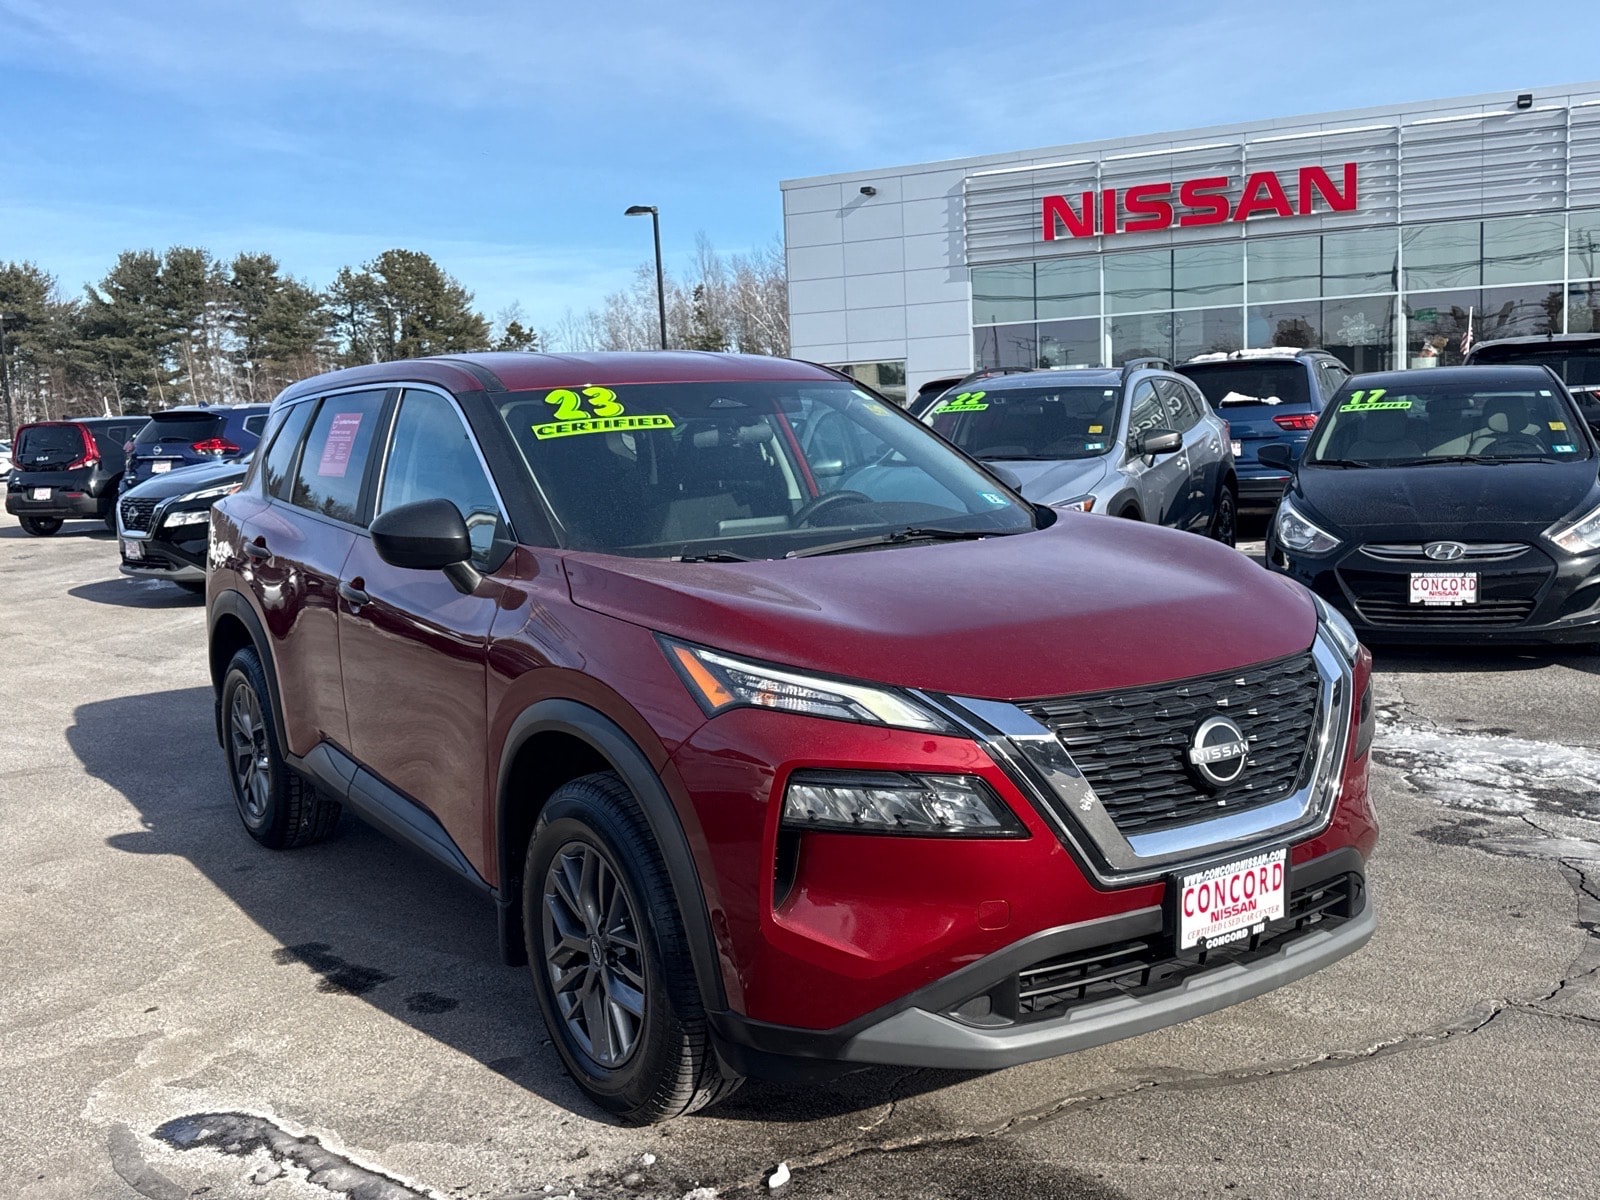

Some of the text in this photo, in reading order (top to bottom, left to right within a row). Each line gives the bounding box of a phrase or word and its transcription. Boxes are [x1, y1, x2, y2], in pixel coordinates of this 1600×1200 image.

[1042, 162, 1357, 241] NISSAN
[544, 386, 625, 421] 23
[950, 391, 986, 406] 22
[1341, 402, 1409, 411] CERTIFIED
[1350, 388, 1387, 405] 17
[935, 404, 987, 413] CERTIFIED
[536, 416, 669, 436] CERTIFIED
[1412, 579, 1477, 591] CONCORD
[1191, 741, 1249, 762] NISSAN
[1184, 863, 1283, 918] CONCORD
[1210, 898, 1257, 923] NISSAN
[1187, 922, 1223, 941] CERTIFIED
[1241, 912, 1255, 923] CAR
[1206, 922, 1265, 950] CONCORD NH
